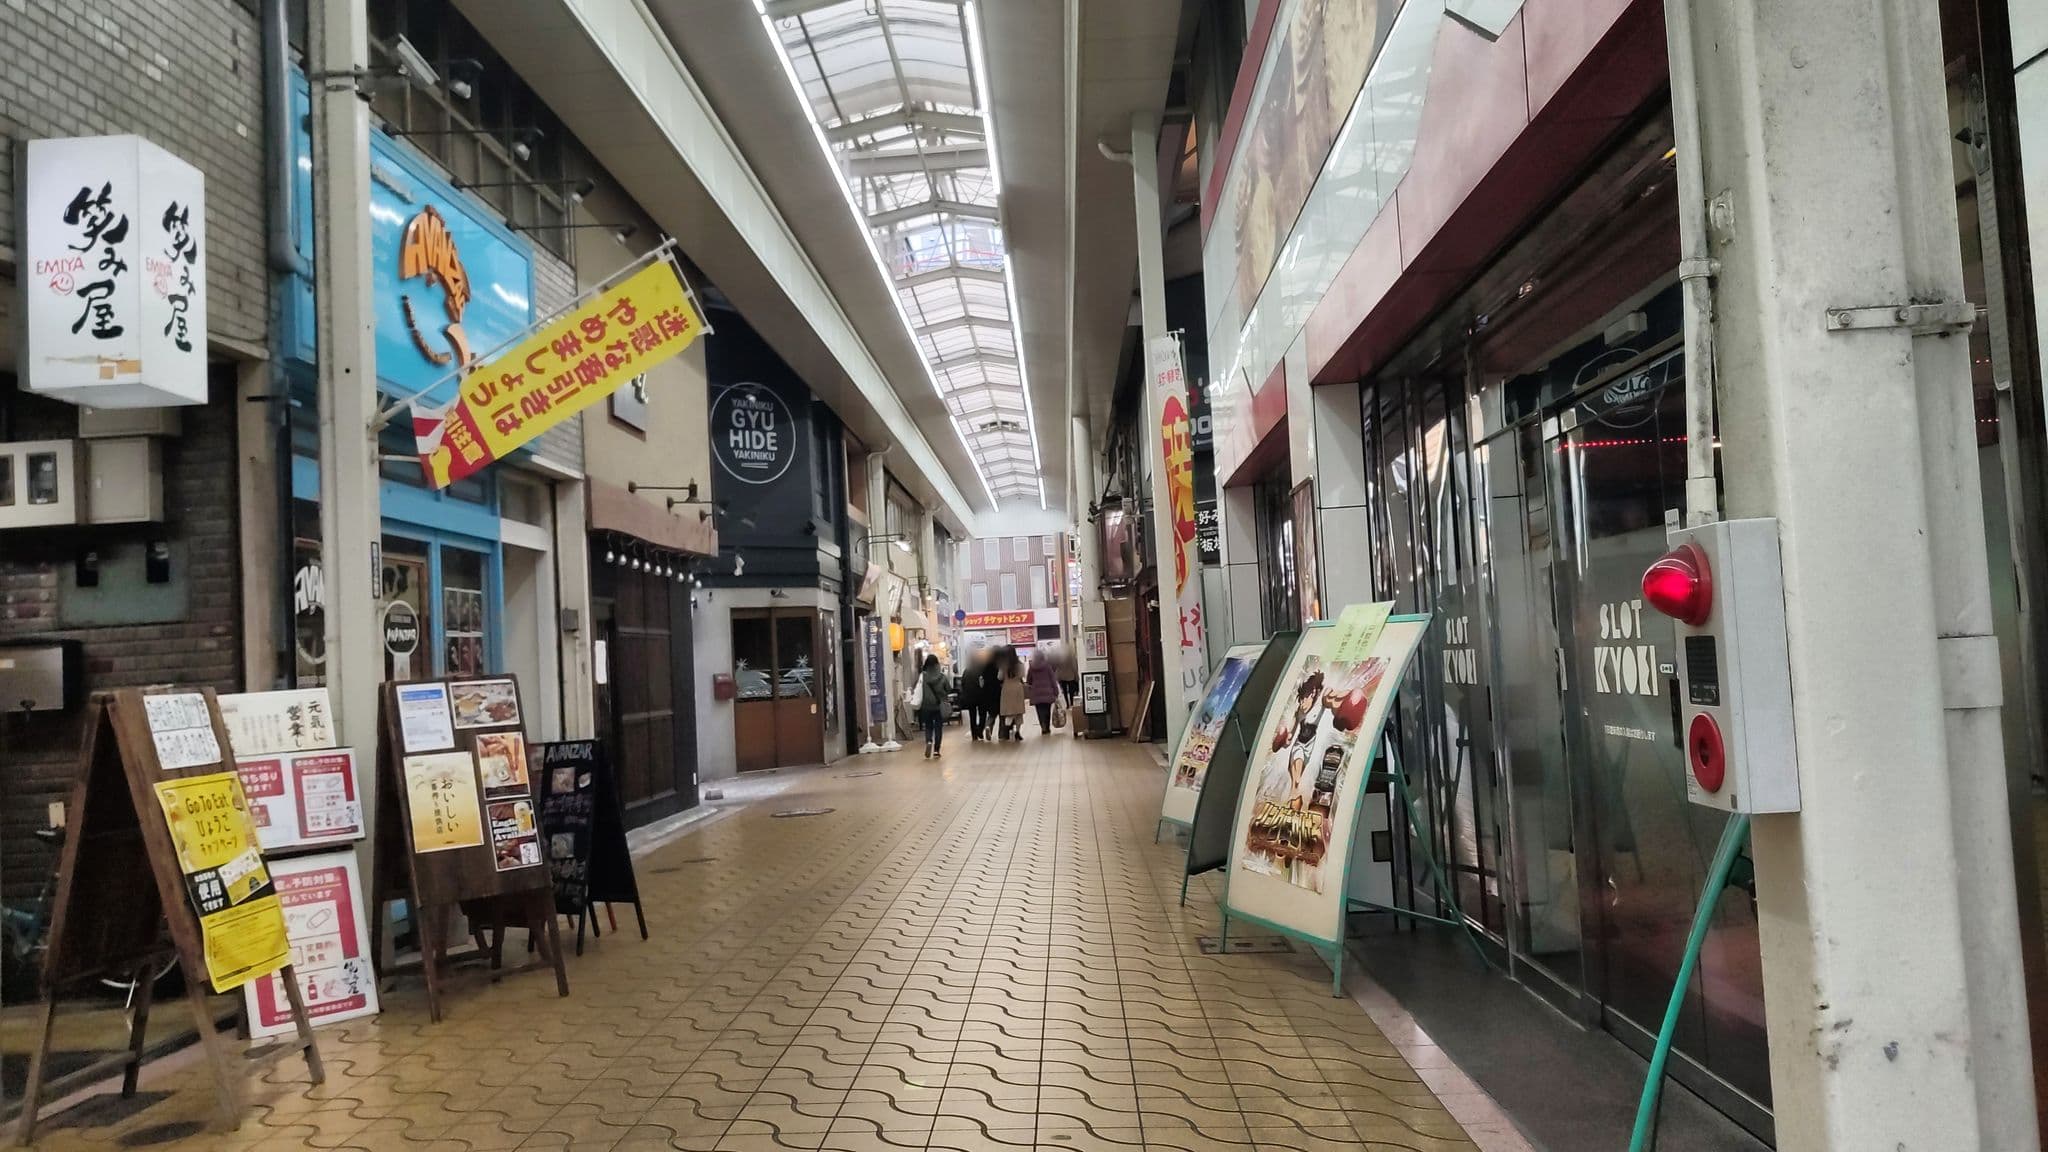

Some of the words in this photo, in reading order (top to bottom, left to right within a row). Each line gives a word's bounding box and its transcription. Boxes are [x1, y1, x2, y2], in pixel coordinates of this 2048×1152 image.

[36, 257, 85, 275] EMIYA
[64, 181, 129, 339] 笑み屋
[145, 256, 173, 278] EMIYA
[162, 201, 197, 352] 笑み屋
[469, 296, 639, 407] やめましょう
[490, 305, 691, 437] 迷惑な客引きは
[731, 398, 774, 411] YAKINIKU
[731, 409, 775, 431] GYU
[729, 429, 778, 451] HIDE
[733, 449, 776, 461] YAKINIKU
[1446, 616, 1468, 644] SLOT
[1600, 599, 1642, 640] SLOT
[308, 700, 326, 742] 元気に
[546, 744, 593, 763] AVANZAR
[185, 797, 199, 814] Go
[198, 795, 212, 811] To
[212, 793, 229, 809] Eat
[441, 779, 459, 832] おいしい
[196, 812, 231, 837] ひょうご
[199, 882, 222, 901] 使用
